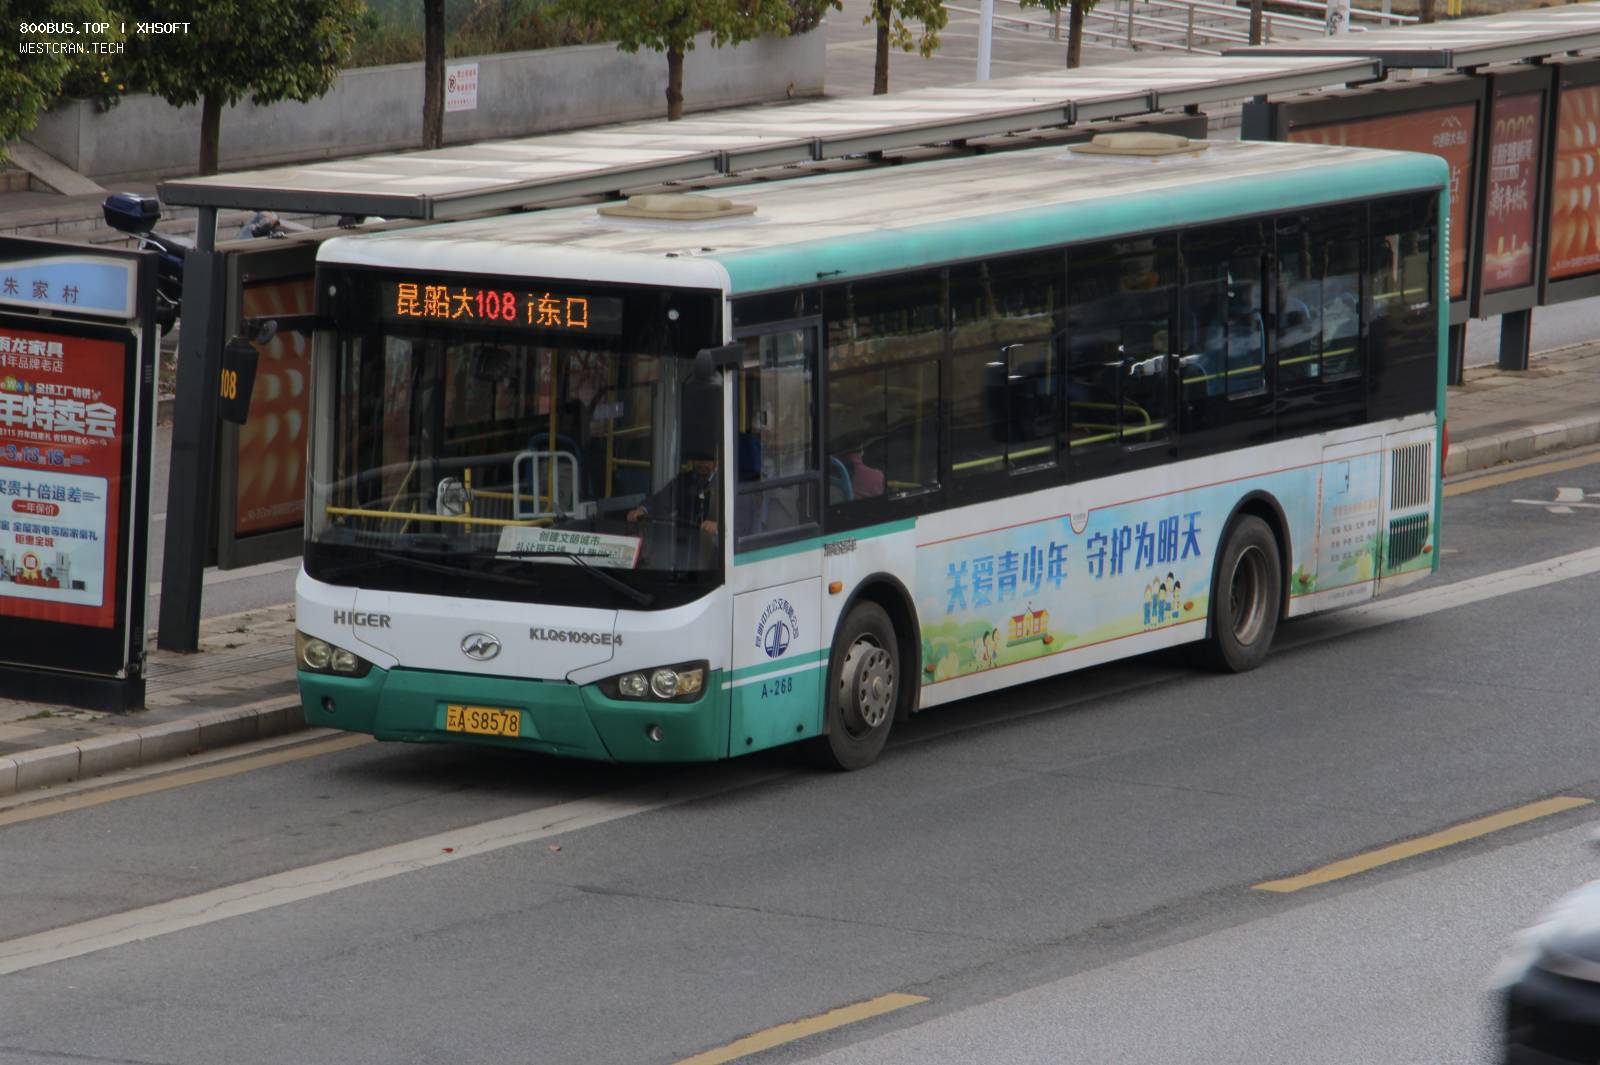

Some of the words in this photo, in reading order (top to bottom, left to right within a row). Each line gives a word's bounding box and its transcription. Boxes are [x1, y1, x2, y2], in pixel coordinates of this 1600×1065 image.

[3, 276, 79, 304] 朱家村
[397, 283, 475, 319] 昆船大
[475, 290, 517, 321] 108
[220, 367, 238, 400] 108
[0, 392, 117, 439] 年特卖会
[946, 541, 1069, 614] 关爱青少年
[1086, 511, 1203, 579] 守护为明天
[333, 610, 391, 629] HIGER
[529, 627, 624, 647] KLQ6109GE4
[761, 677, 793, 699] A-268
